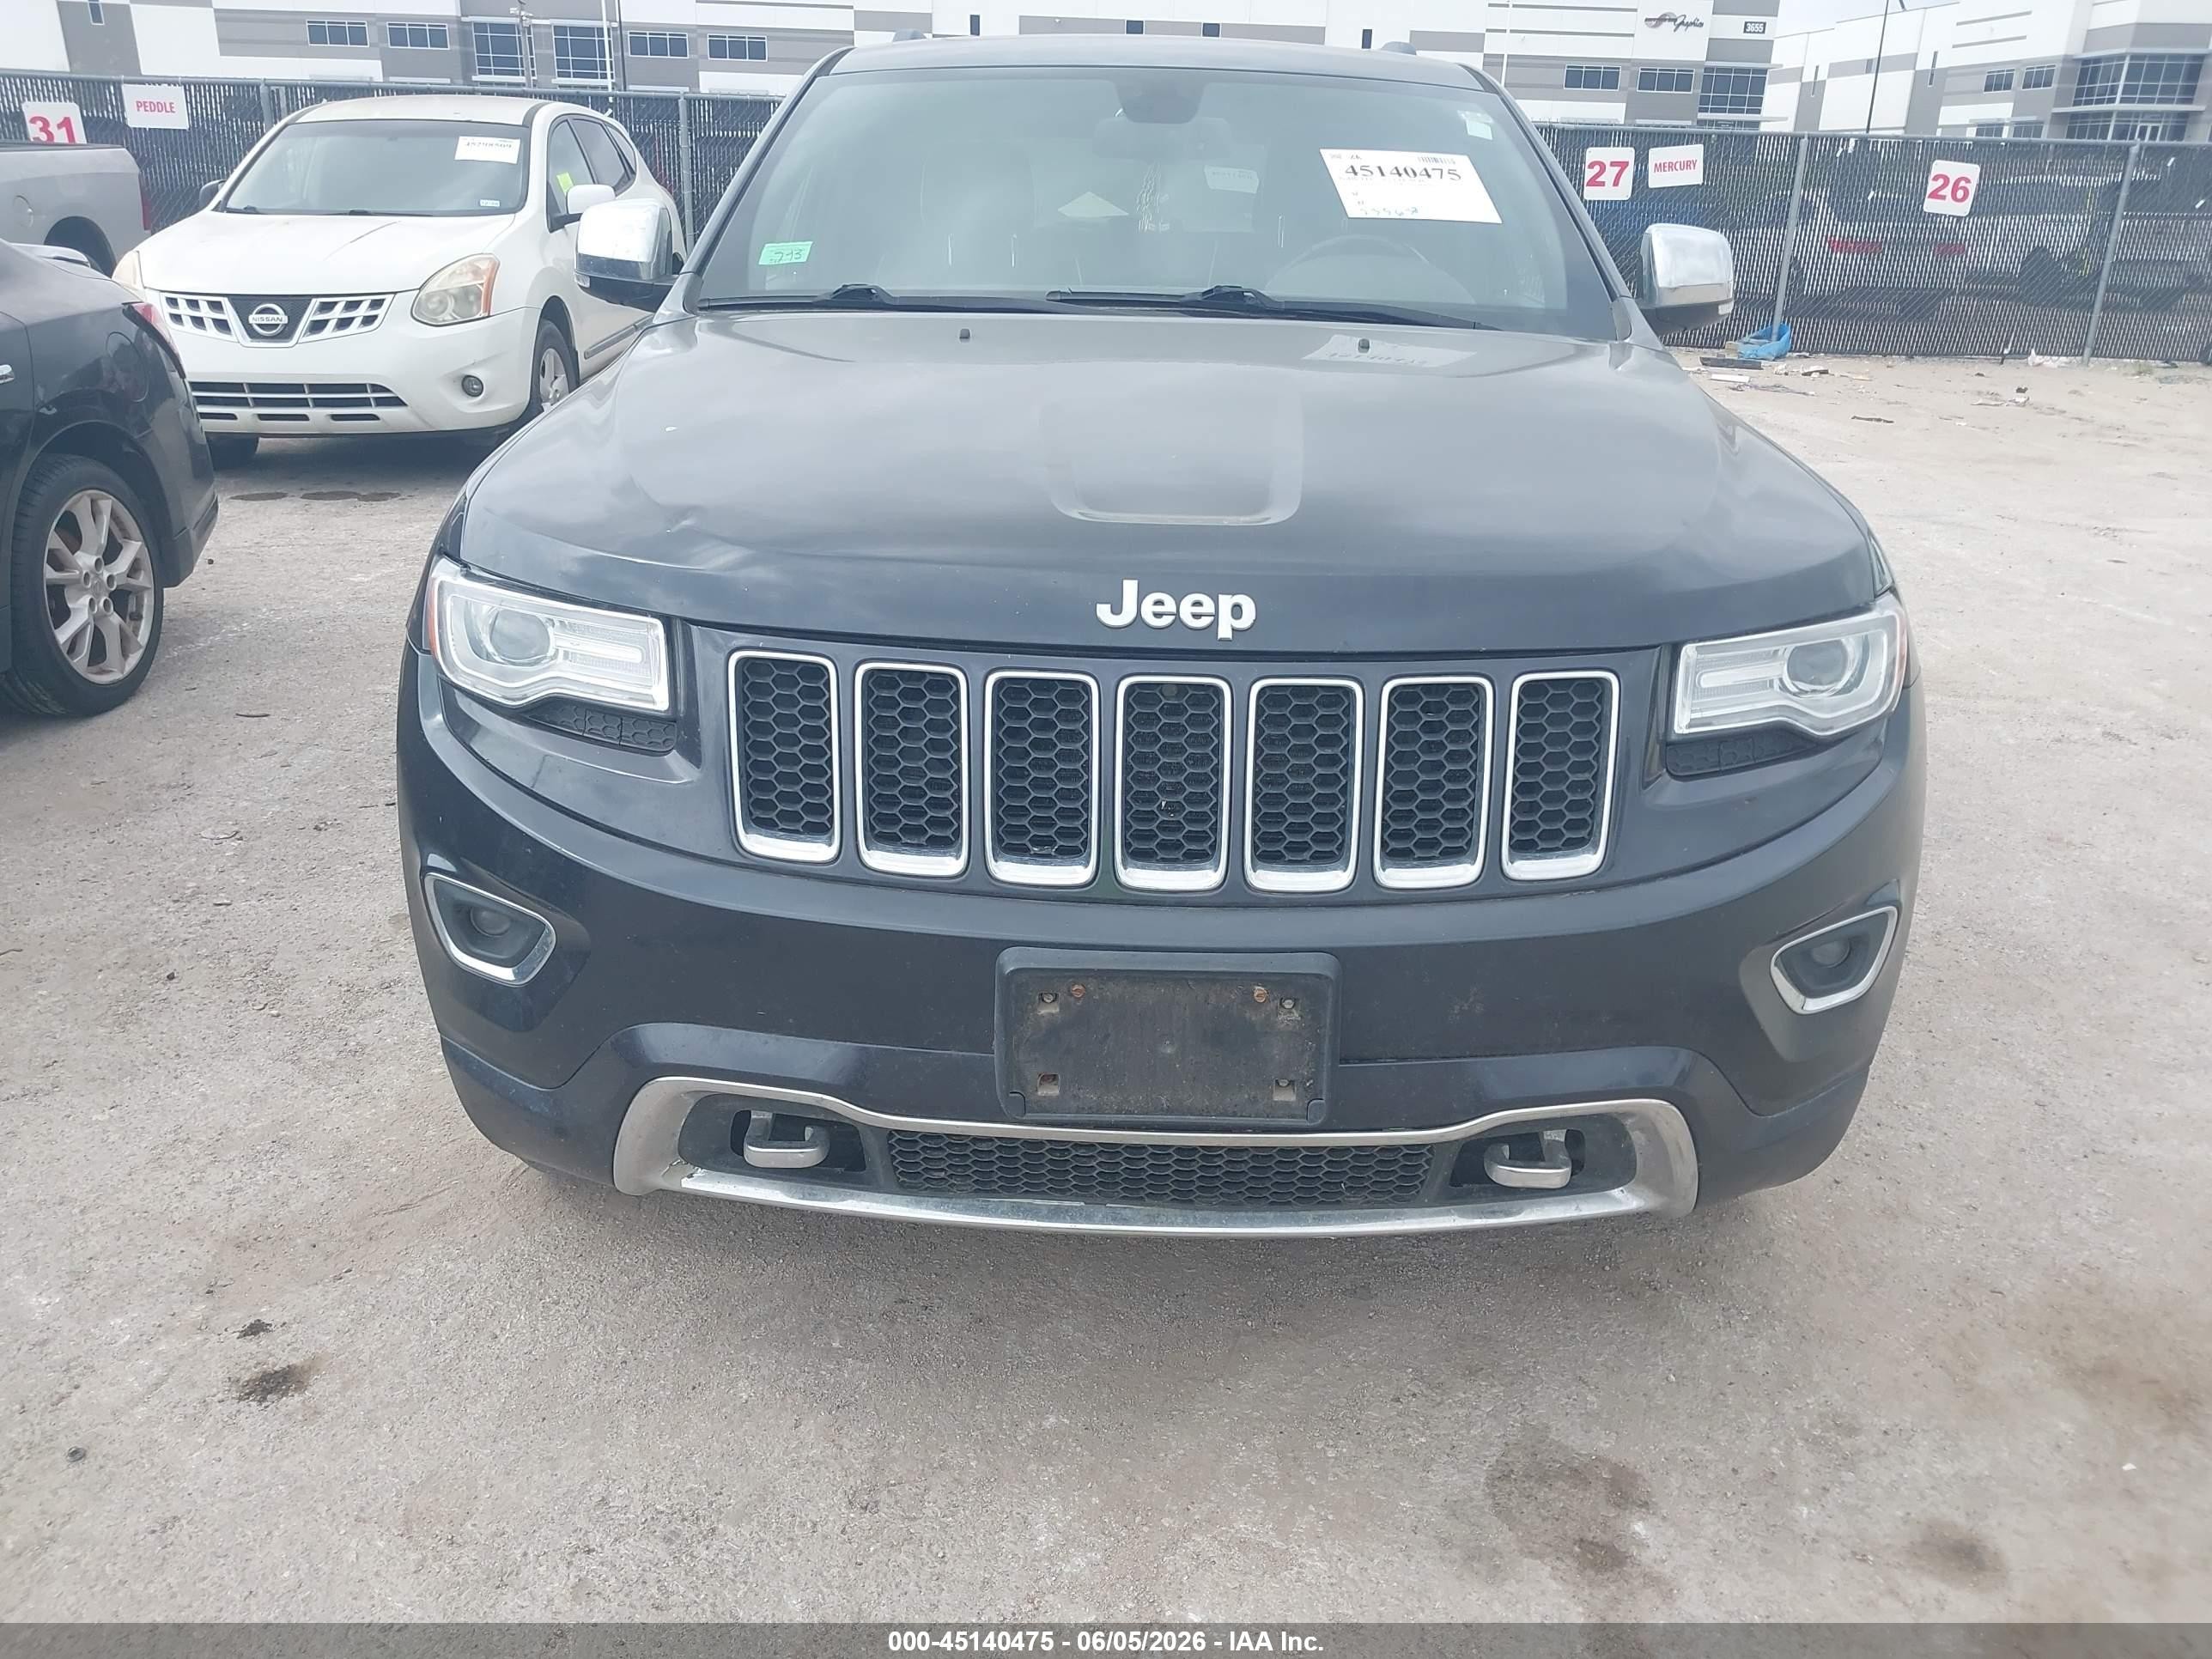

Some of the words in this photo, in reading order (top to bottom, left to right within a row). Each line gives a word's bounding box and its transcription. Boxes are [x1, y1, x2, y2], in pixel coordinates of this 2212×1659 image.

[1745, 22, 1764, 33] 3655
[136, 100, 176, 113] PEDDLE
[29, 116, 76, 143] 31
[1344, 164, 1462, 181] 45140475
[1586, 161, 1629, 187] 27
[1654, 159, 1698, 173] MERCURY
[1927, 173, 1972, 204] 26
[1096, 578, 1257, 641] Jeep
